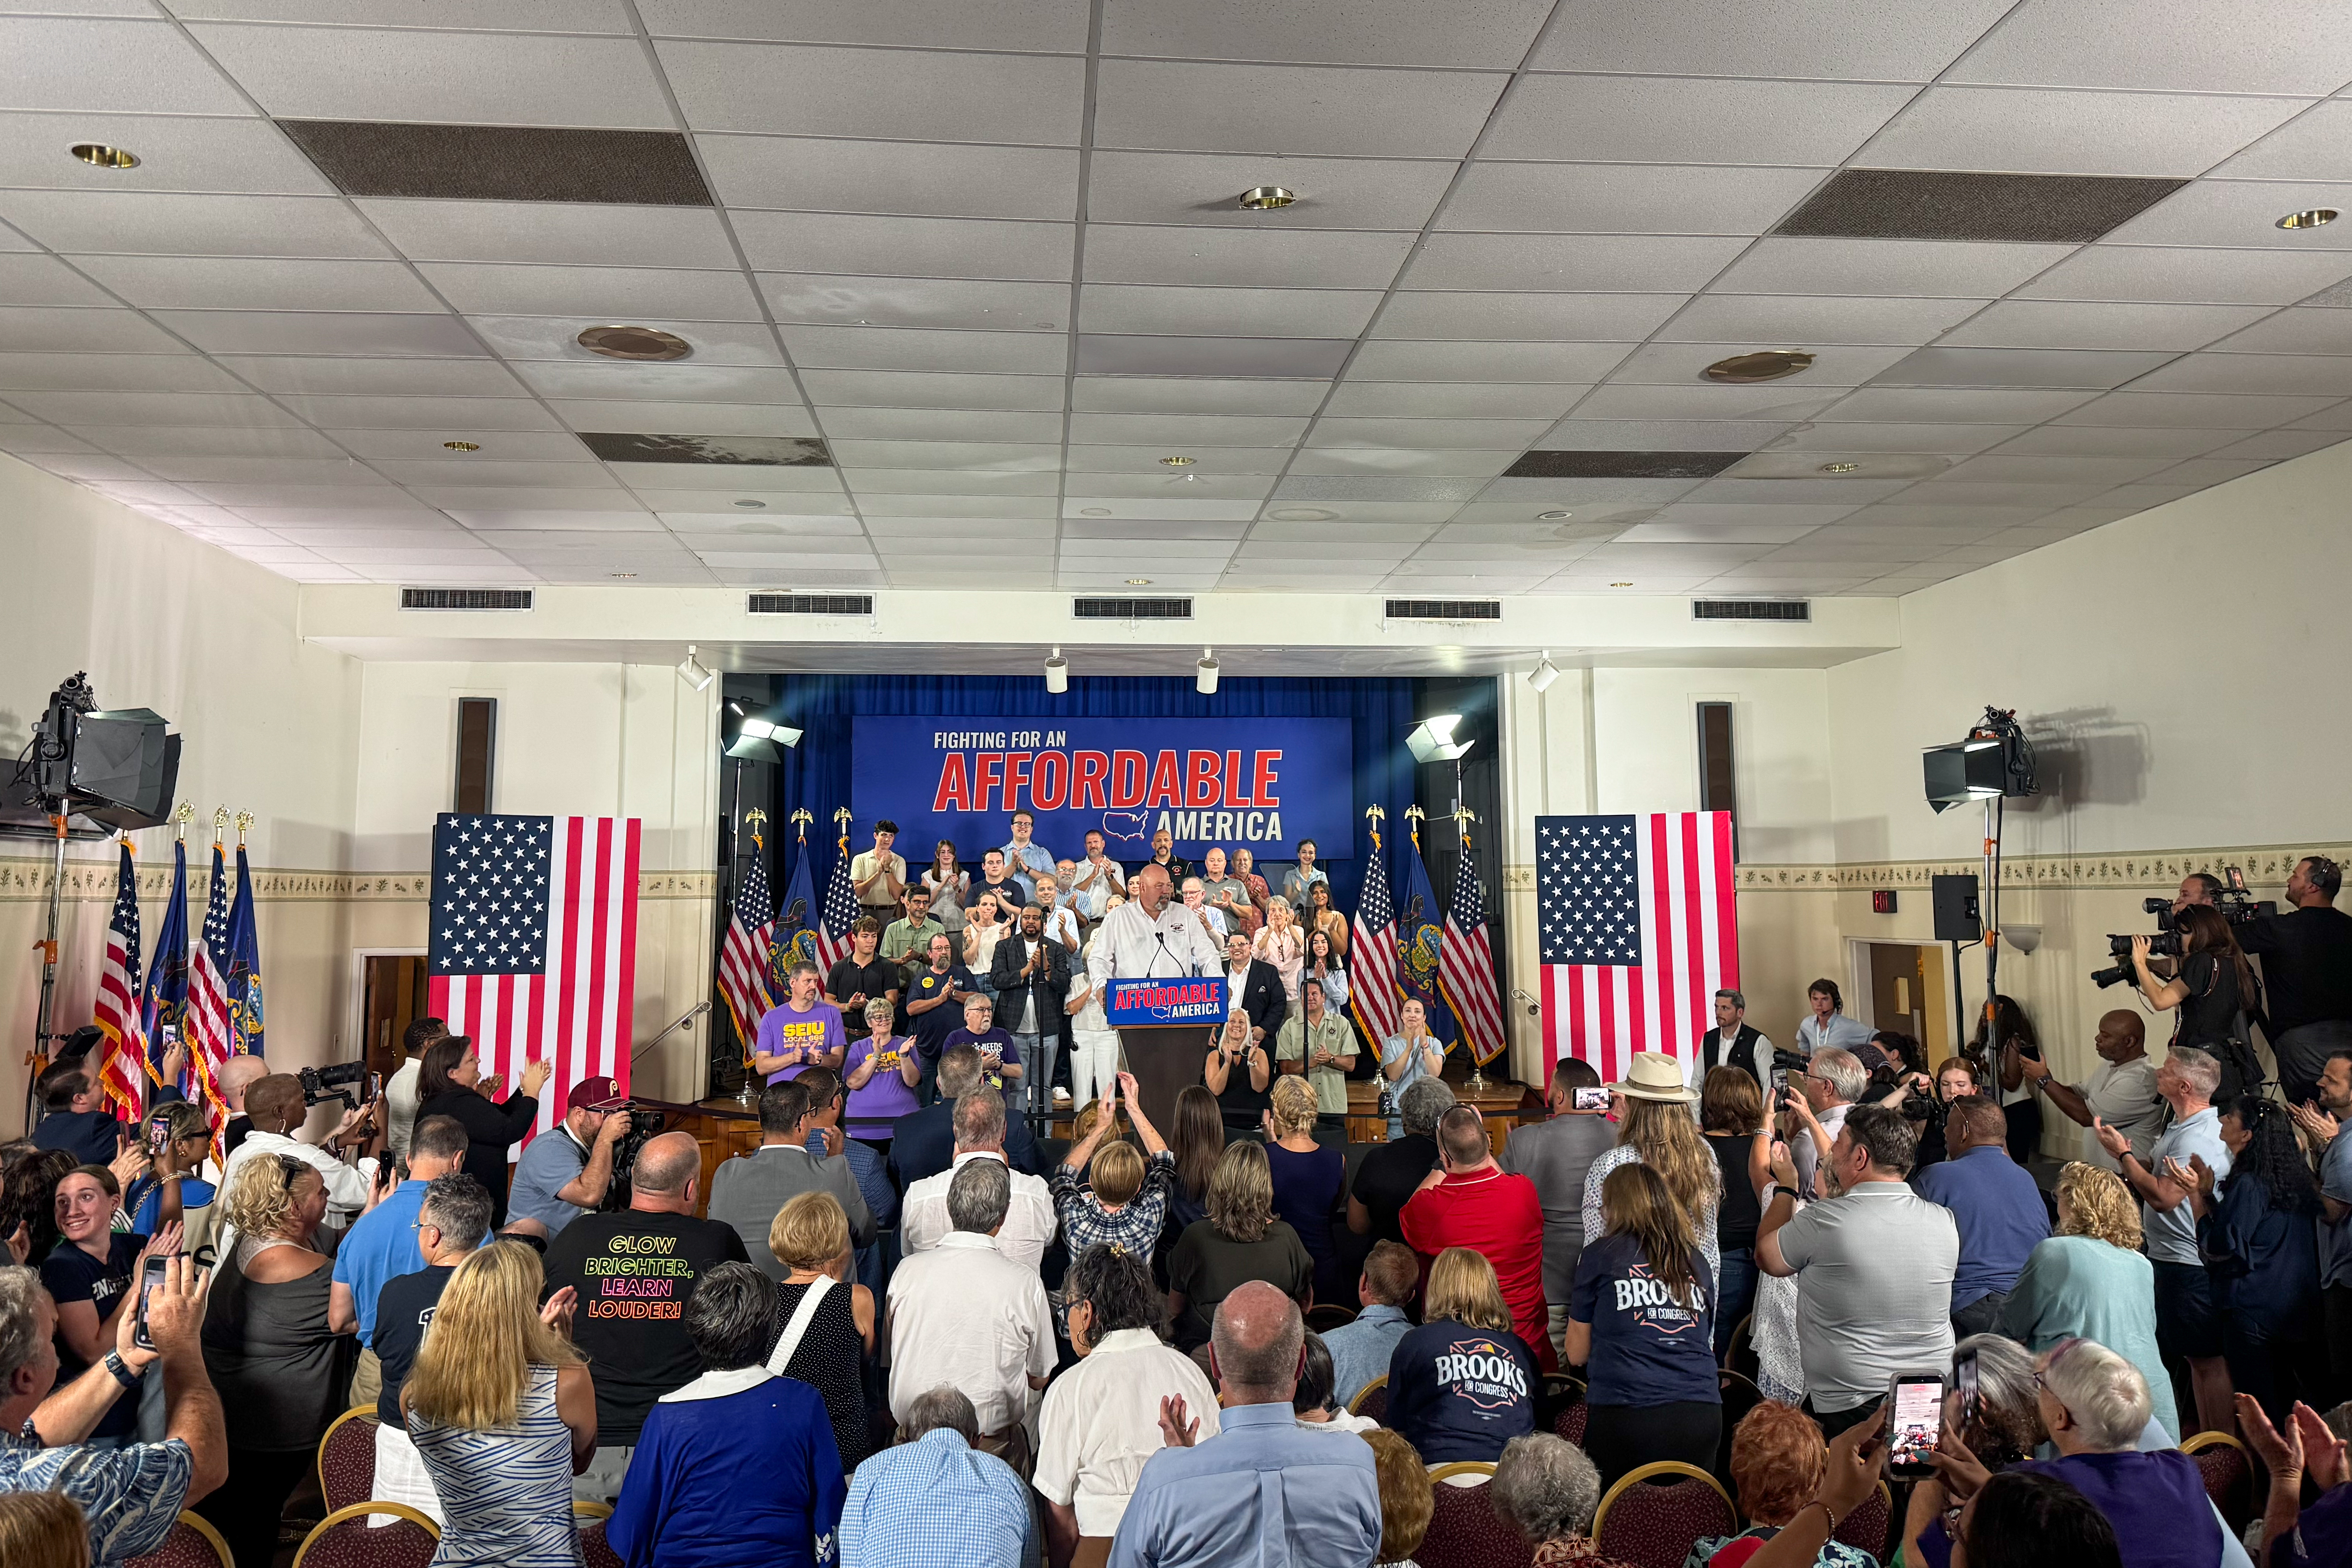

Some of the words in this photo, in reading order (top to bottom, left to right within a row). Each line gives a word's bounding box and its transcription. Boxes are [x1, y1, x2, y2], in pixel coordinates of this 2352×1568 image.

[934, 732, 1006, 748] FIGHTING
[1011, 731, 1041, 748] FOR
[1046, 730, 1066, 747] AN
[932, 749, 1282, 812] AFFORDABLE
[1156, 810, 1282, 841] AMERICA
[1115, 982, 1220, 1010] AFFORDABLE
[1172, 1002, 1220, 1018] AMERICA
[783, 1022, 825, 1037] SEIU
[609, 1236, 677, 1254] GLOW
[585, 1258, 694, 1278] BRIGHTER,
[601, 1279, 672, 1296] LEARN
[588, 1300, 681, 1319] LOUDER!
[1647, 1309, 1657, 1318] FOR
[1658, 1308, 1691, 1321] CONGRESS
[1435, 1354, 1527, 1397] BROOKS
[1465, 1381, 1474, 1391] FOR
[1475, 1382, 1508, 1398] CONGRESS
